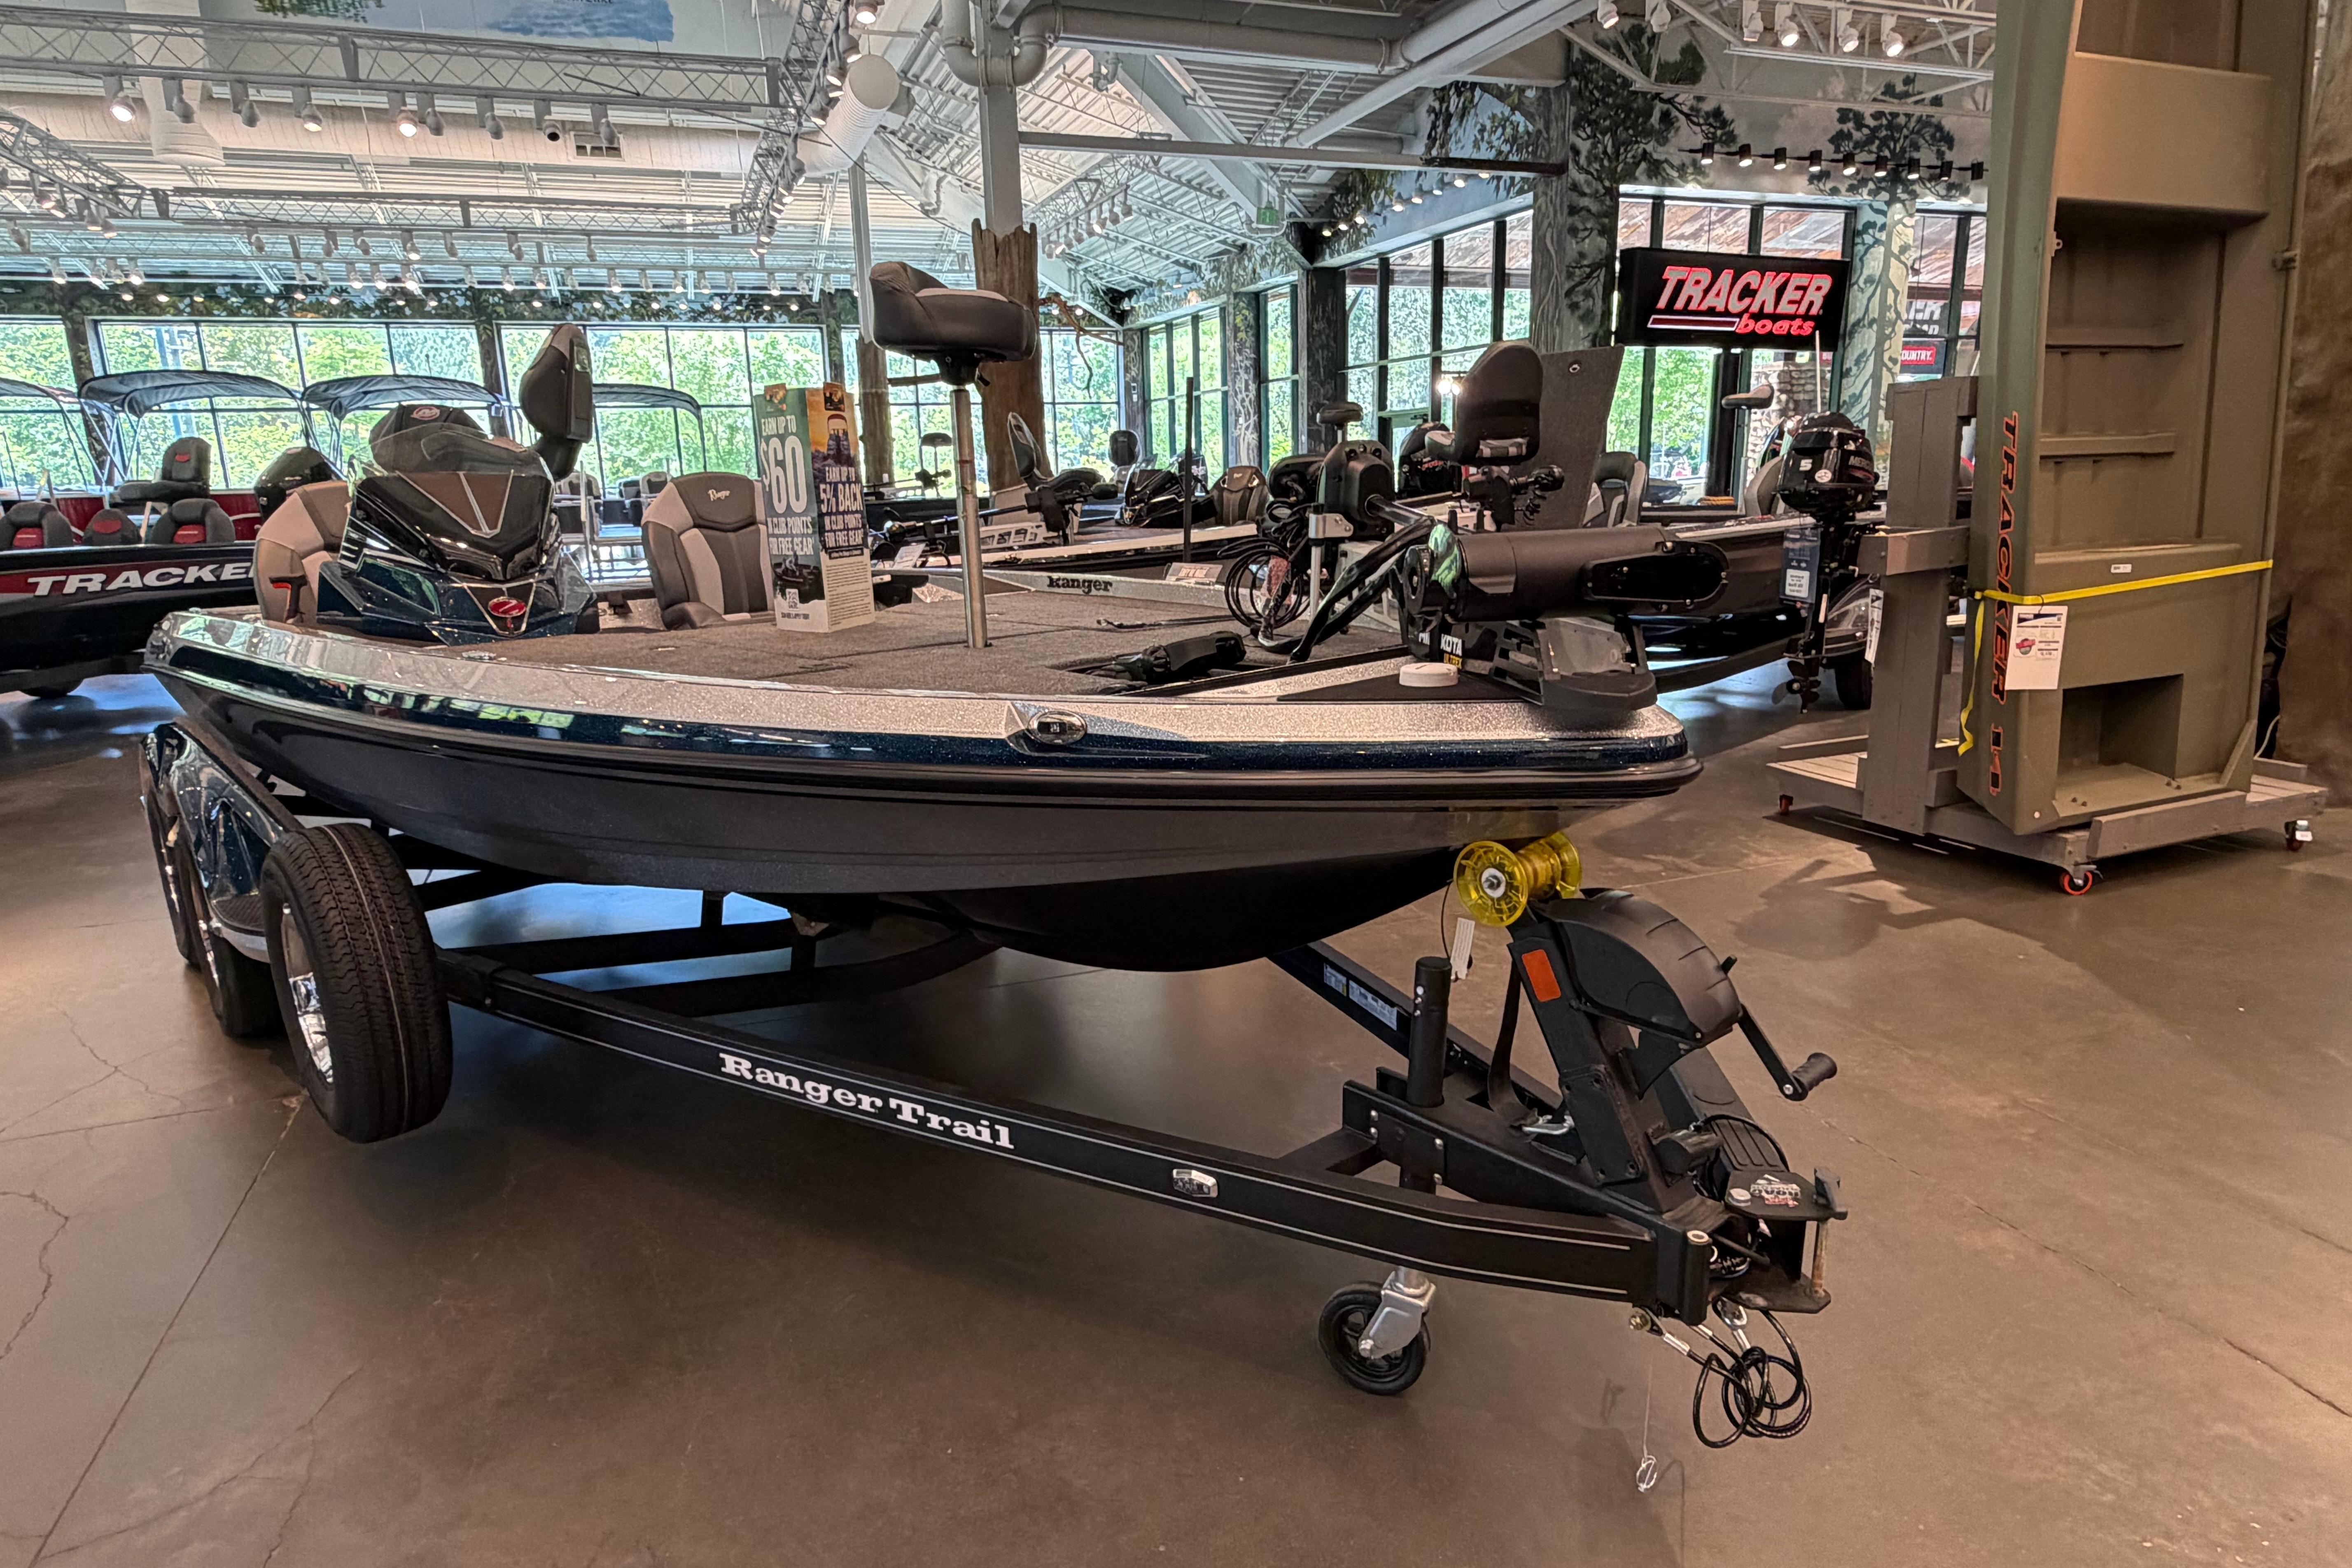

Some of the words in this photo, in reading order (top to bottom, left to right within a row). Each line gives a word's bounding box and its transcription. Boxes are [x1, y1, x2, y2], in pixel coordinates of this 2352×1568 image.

[1655, 266, 1832, 315] TRACKER
[1735, 313, 1815, 336] boats
[761, 417, 777, 435] EARN
[777, 416, 786, 434] UP
[786, 415, 797, 433] TO
[760, 435, 807, 514] $60
[825, 467, 839, 483] EARN
[840, 467, 847, 482] UP
[848, 467, 855, 481] TO
[1799, 459, 1813, 471] 5
[819, 484, 836, 513] 5%
[838, 483, 863, 512] BACK
[772, 517, 786, 534] CLUB
[787, 516, 813, 534] POINTS
[831, 515, 844, 530] CLUB
[844, 514, 862, 529] POINTS
[778, 537, 793, 555] FREE
[825, 532, 836, 548] FOR
[836, 531, 848, 547] FREE
[27, 562, 254, 596] TRACKE
[1047, 576, 1113, 594] Ranger
[1440, 634, 1463, 656] KOTA
[719, 1052, 882, 1113] Ranger
[889, 1099, 1015, 1149] Trail
